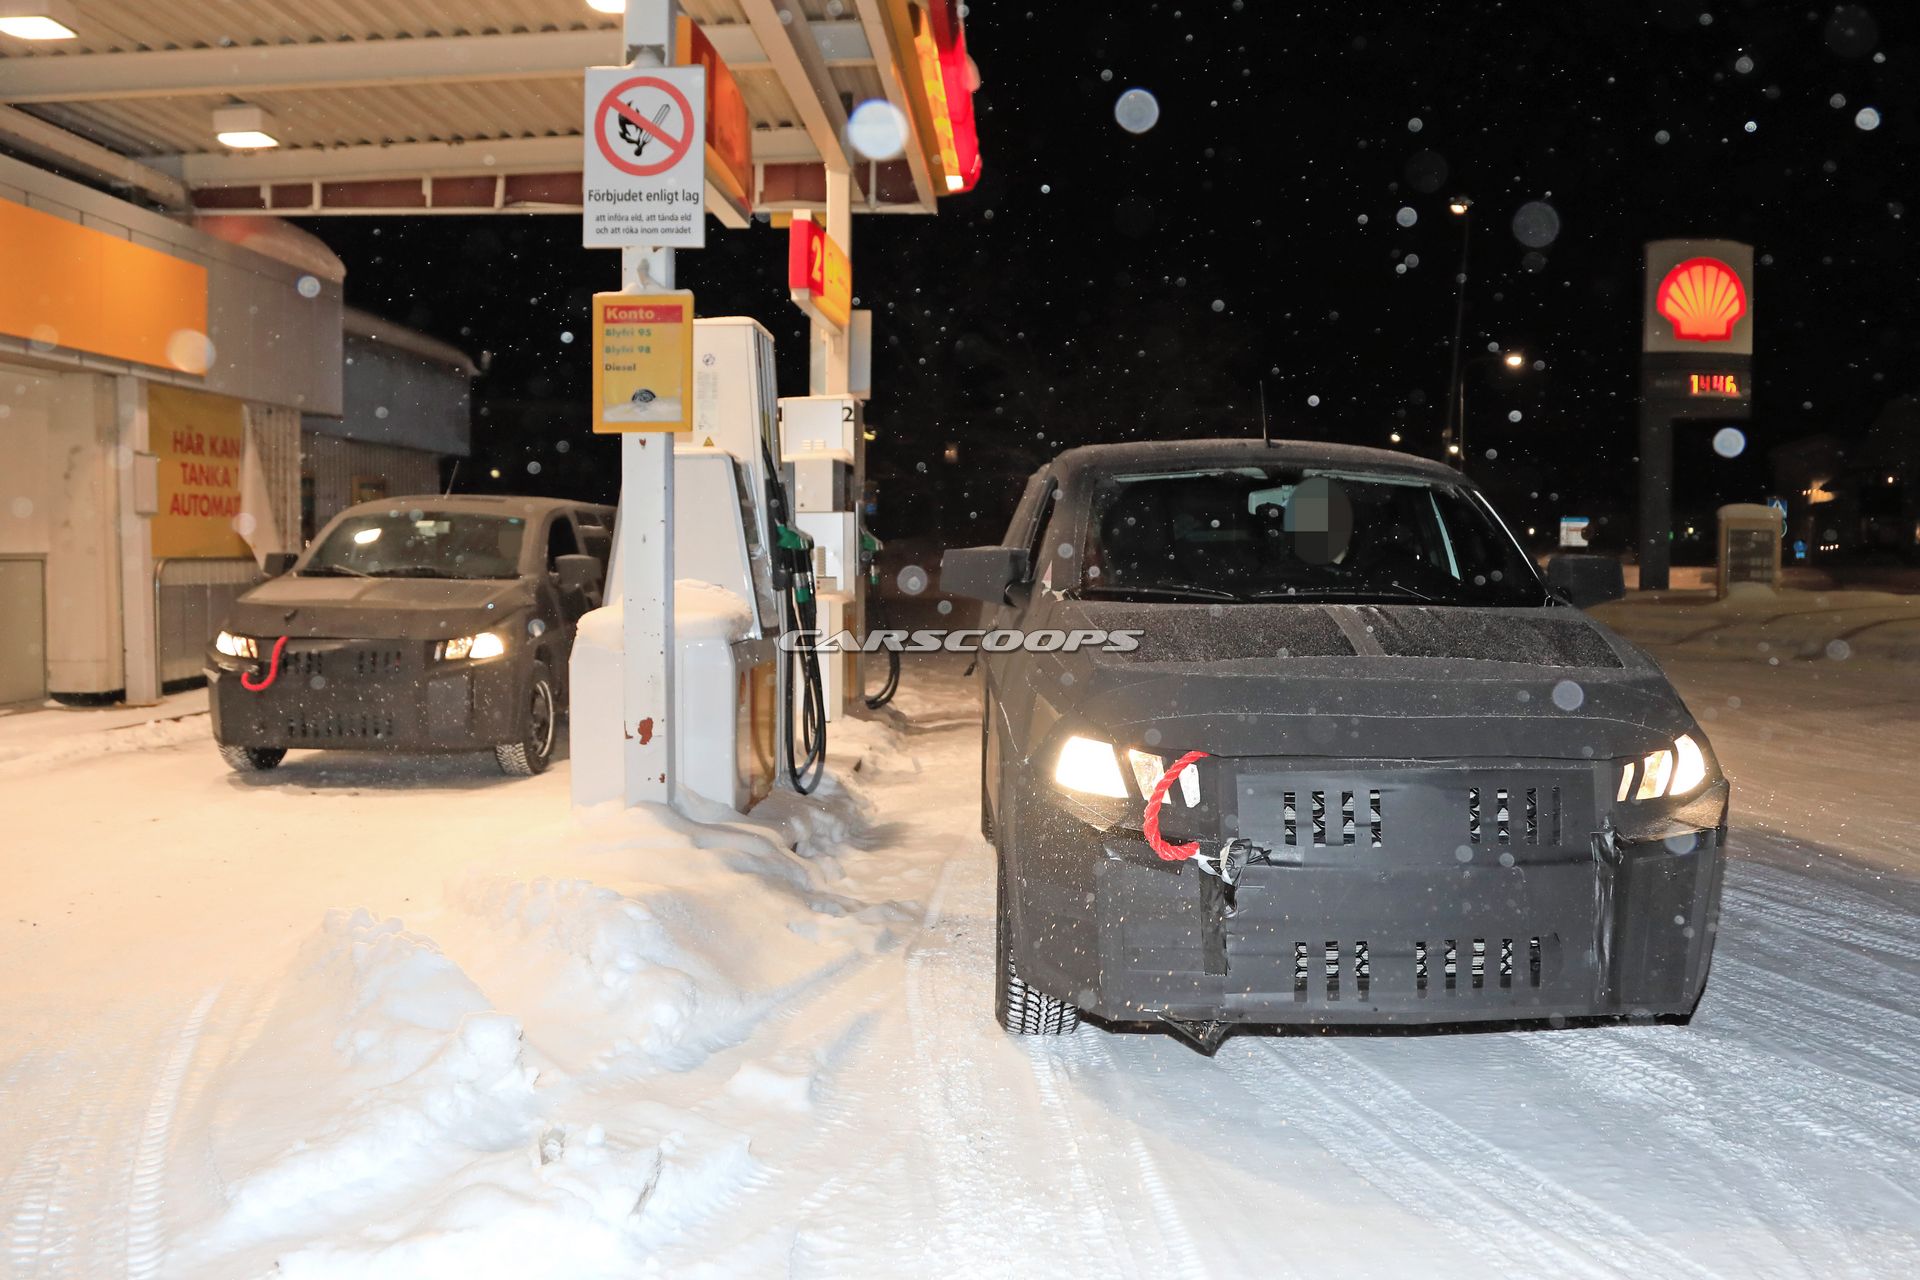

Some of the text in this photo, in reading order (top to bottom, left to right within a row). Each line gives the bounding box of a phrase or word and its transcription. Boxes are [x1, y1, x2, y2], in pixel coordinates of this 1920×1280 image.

[588, 188, 700, 205] Förbjudet enligt lag
[595, 213, 606, 222] att
[607, 213, 629, 222] införa
[646, 213, 656, 222] att
[658, 213, 679, 222] tända
[680, 213, 692, 222] eld
[595, 225, 691, 234] och att röka inom området
[811, 234, 823, 283] 2
[606, 307, 655, 320] Konto
[638, 328, 652, 337] 95
[604, 363, 637, 372] Diesel
[842, 406, 855, 422] 2
[180, 462, 231, 488] TANKA
